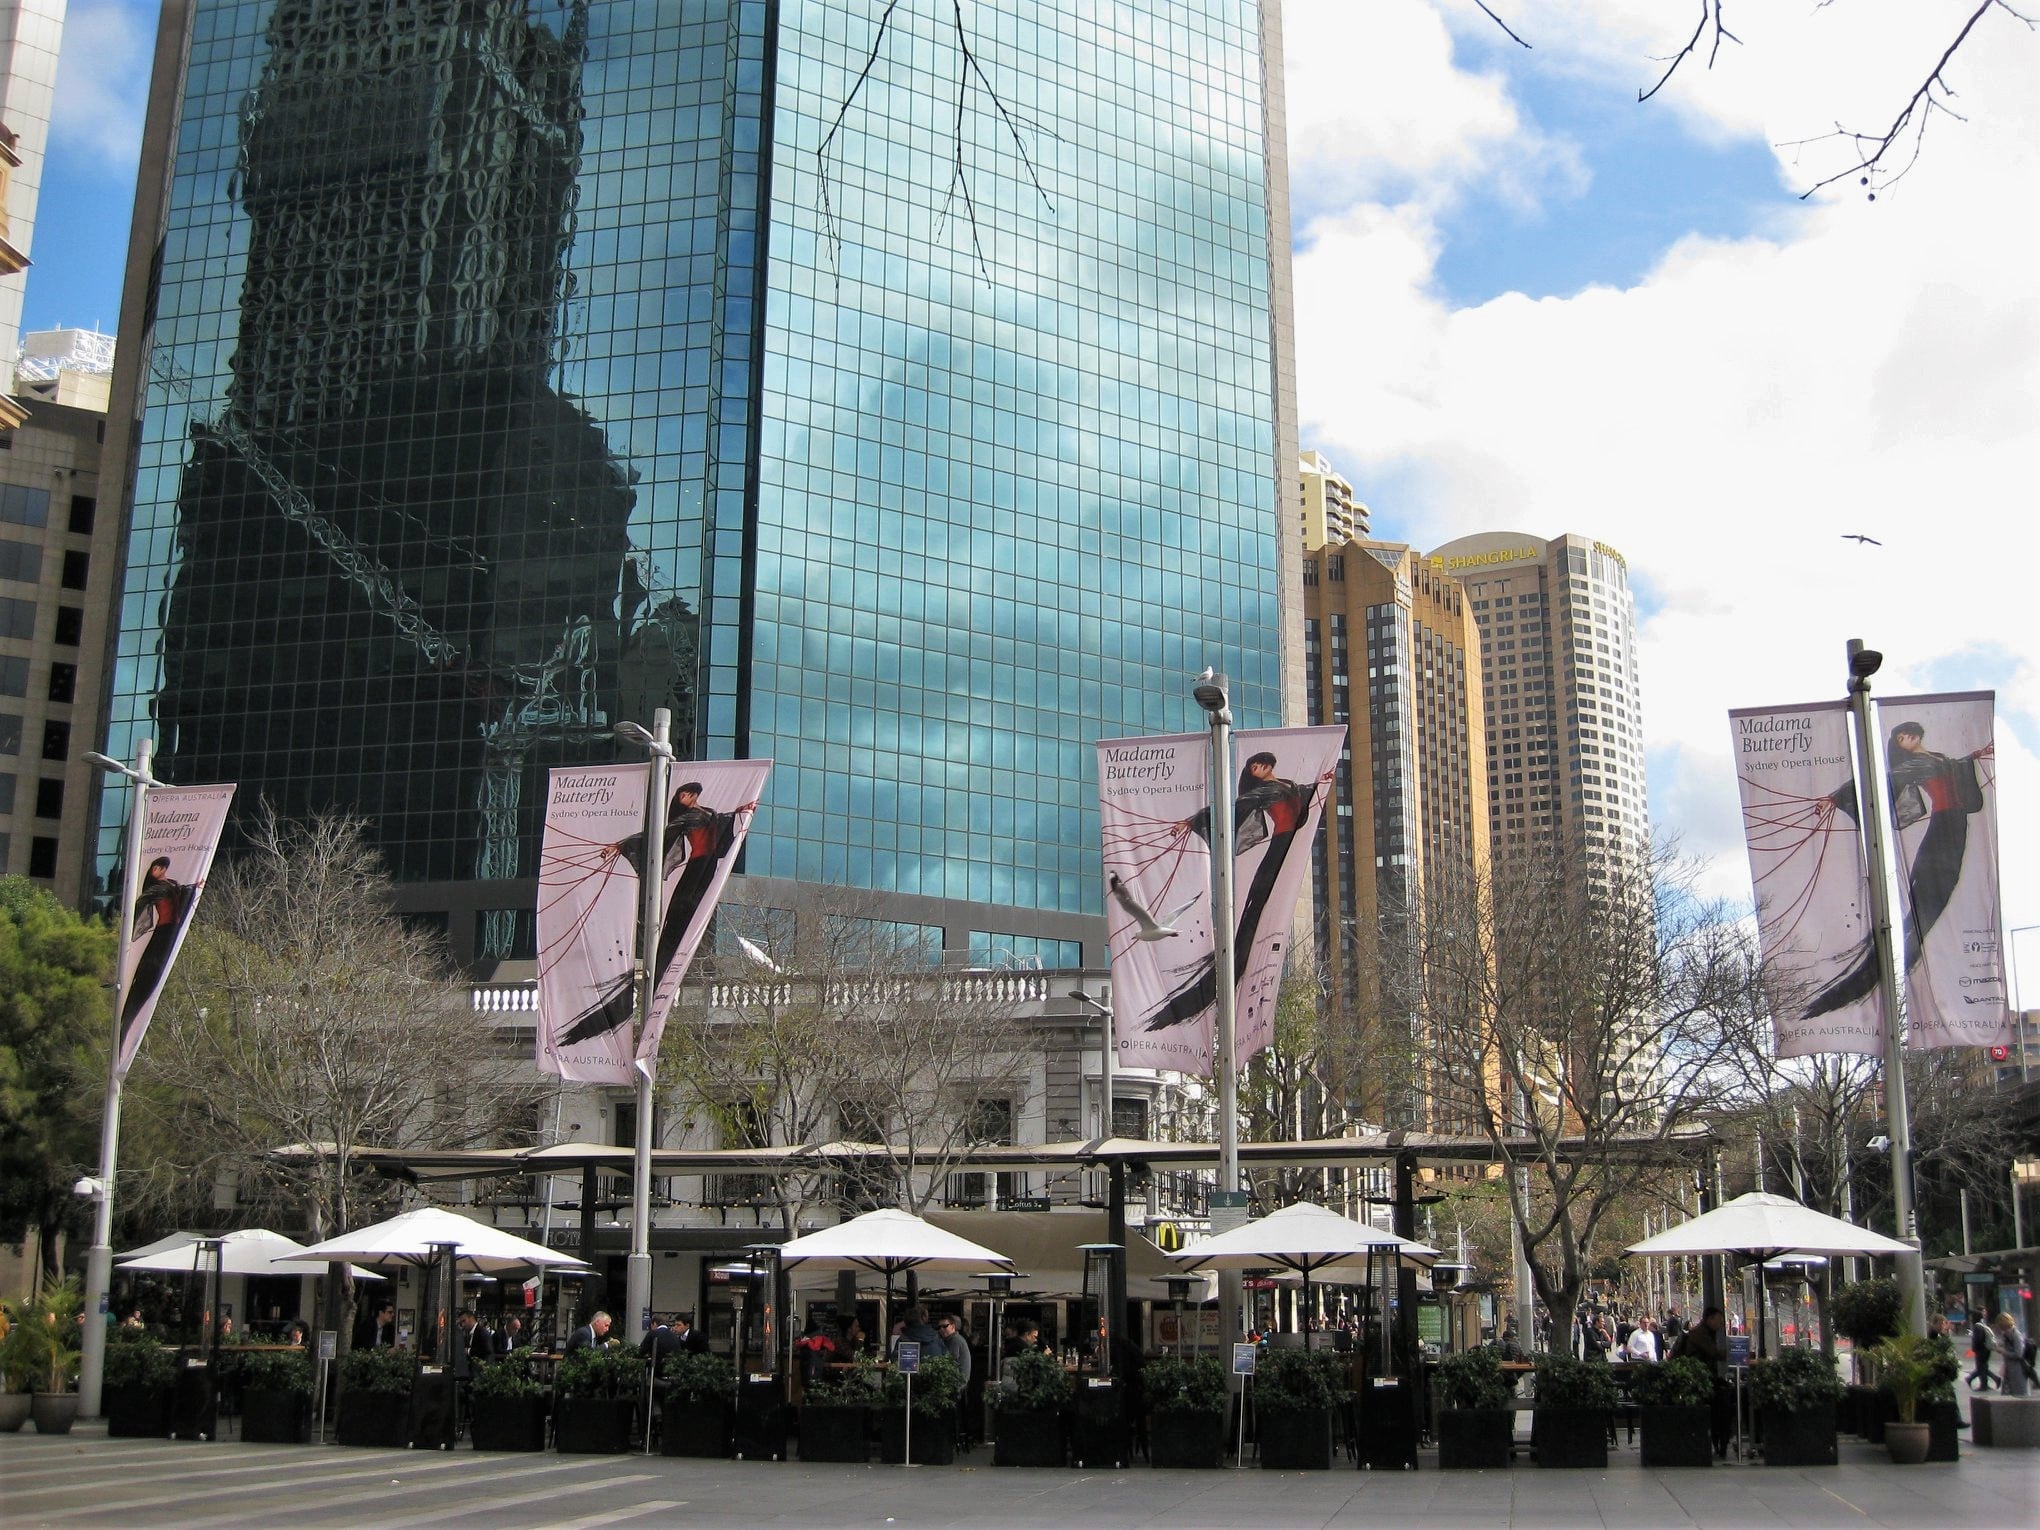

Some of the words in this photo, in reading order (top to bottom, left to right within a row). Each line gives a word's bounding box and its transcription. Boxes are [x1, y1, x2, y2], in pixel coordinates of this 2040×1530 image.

[1449, 545, 1537, 570] SHANGRI-LA
[1739, 716, 1812, 735] Madama
[1742, 733, 1813, 753] Butterfly
[1105, 746, 1176, 763] Madama
[1106, 762, 1175, 781] Butterfly
[1745, 762, 1779, 773] Sydney
[1781, 759, 1812, 769] Opera
[1814, 755, 1846, 766] House
[555, 775, 617, 789] Madama
[1107, 786, 1140, 797] Sydney
[1142, 785, 1172, 795] Opera
[1175, 783, 1205, 793] House
[552, 788, 614, 805] Butterfly
[147, 810, 201, 824] Madama
[550, 810, 578, 820] Sydney
[581, 809, 608, 818] Opera
[610, 808, 639, 817] House
[144, 824, 196, 841] Butterfly
[143, 846, 163, 854] ydney
[164, 845, 186, 854] Opera
[1160, 1043, 1209, 1060] AUSTRIA
